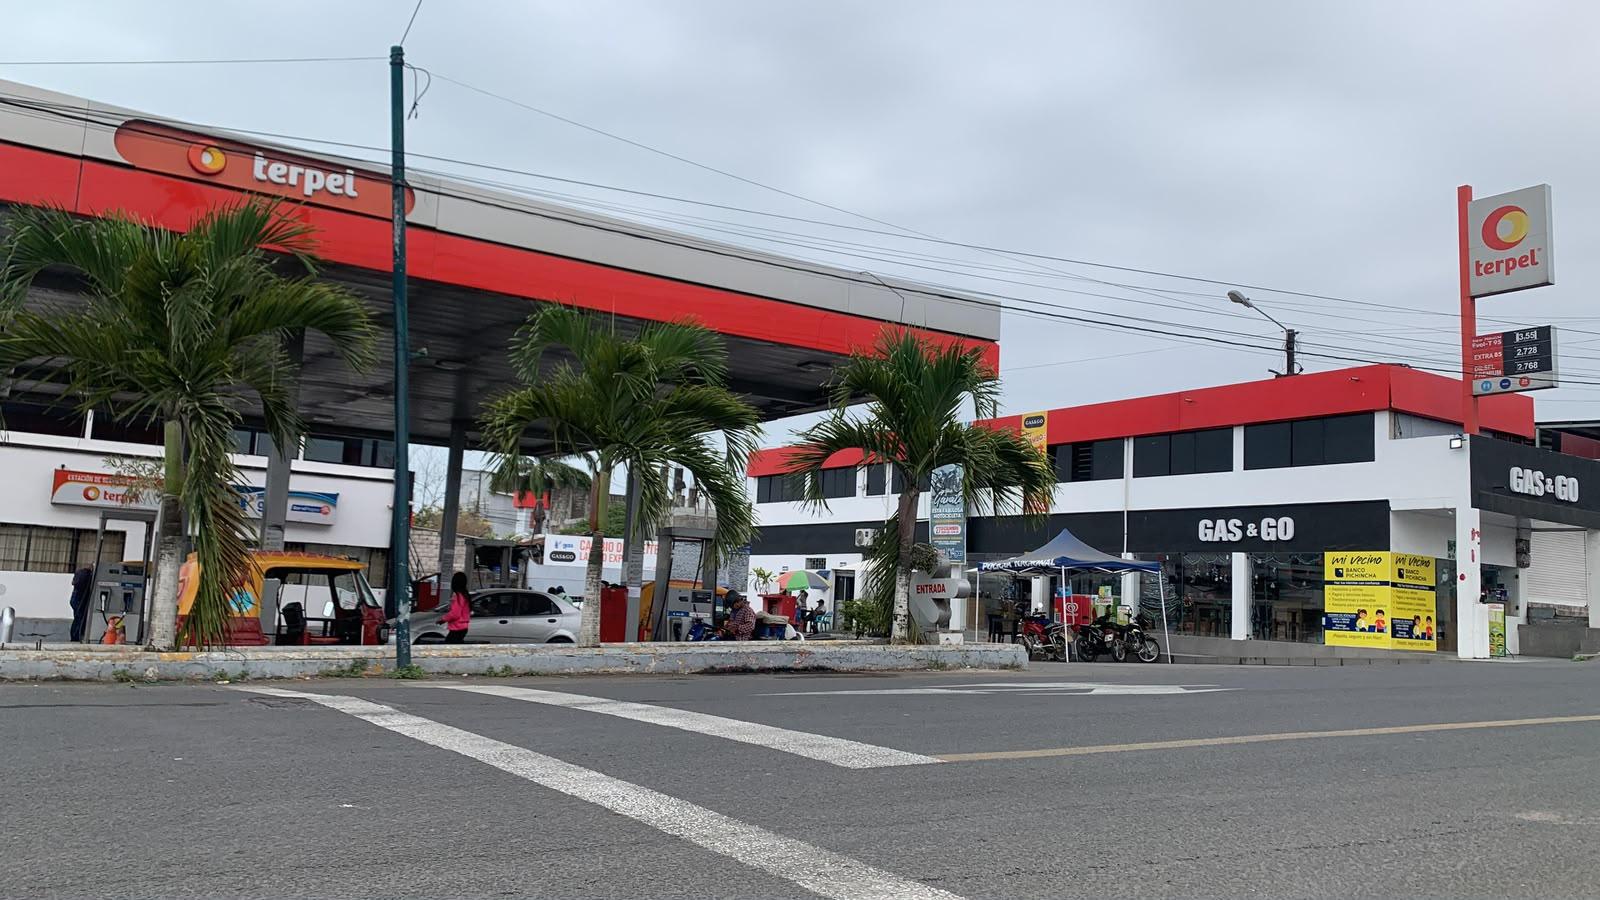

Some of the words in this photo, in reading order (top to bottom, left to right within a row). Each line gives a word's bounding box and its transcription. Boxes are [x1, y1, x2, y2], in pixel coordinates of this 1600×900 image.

[253, 151, 359, 198] terpel
[1474, 248, 1539, 277] terpel
[1474, 353, 1493, 361] EXTRA
[1509, 466, 1545, 497] GAS
[1555, 475, 1579, 503] GO
[1198, 518, 1243, 542] GAS
[1246, 523, 1258, 537] &
[1260, 516, 1295, 541] GO
[916, 583, 946, 594] ENTRADA
